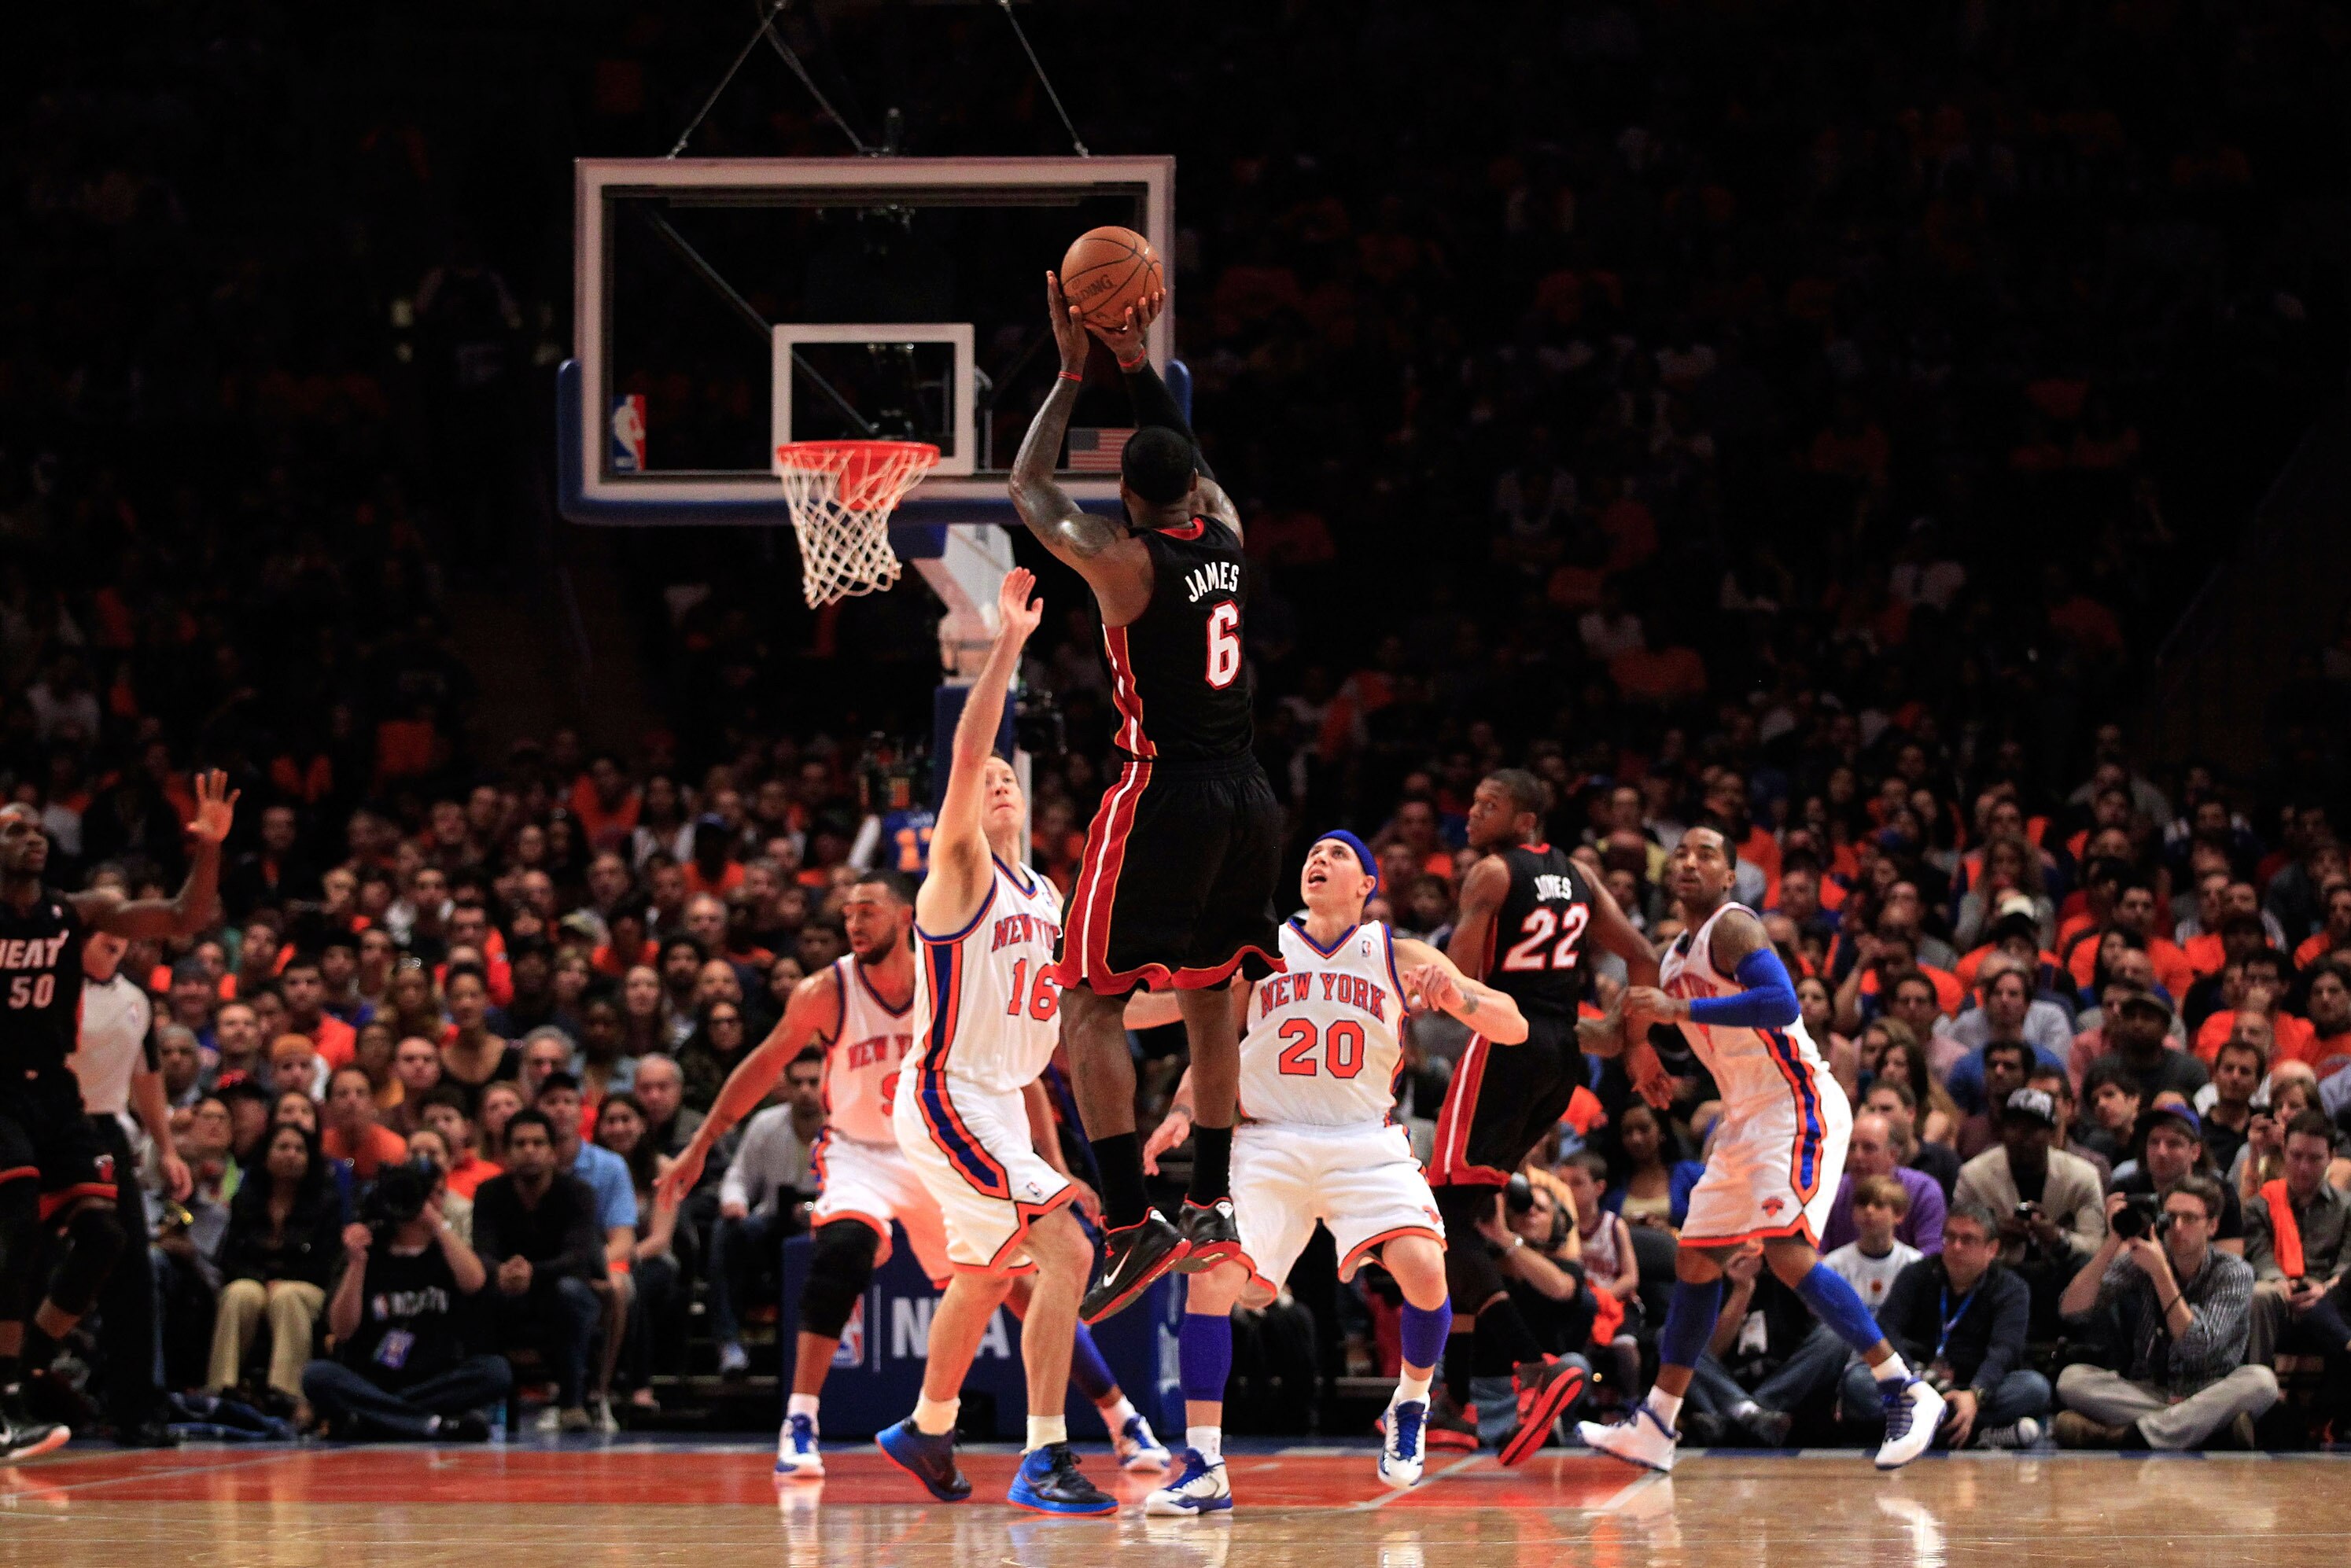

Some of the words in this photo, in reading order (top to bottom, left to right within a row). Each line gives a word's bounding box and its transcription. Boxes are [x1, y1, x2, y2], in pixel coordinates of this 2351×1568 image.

[1185, 561, 1240, 602] JAMES
[1205, 599, 1242, 690] 6
[1535, 874, 1572, 902] JONES
[992, 913, 1032, 952] NEW
[1502, 902, 1590, 972] 22
[8, 974, 56, 1010] 50
[1008, 958, 1059, 1021] 16
[1260, 971, 1313, 1019] NEW
[1319, 972, 1387, 1024] YORK
[1278, 1018, 1365, 1079] 20
[890, 1296, 1012, 1359] NA
